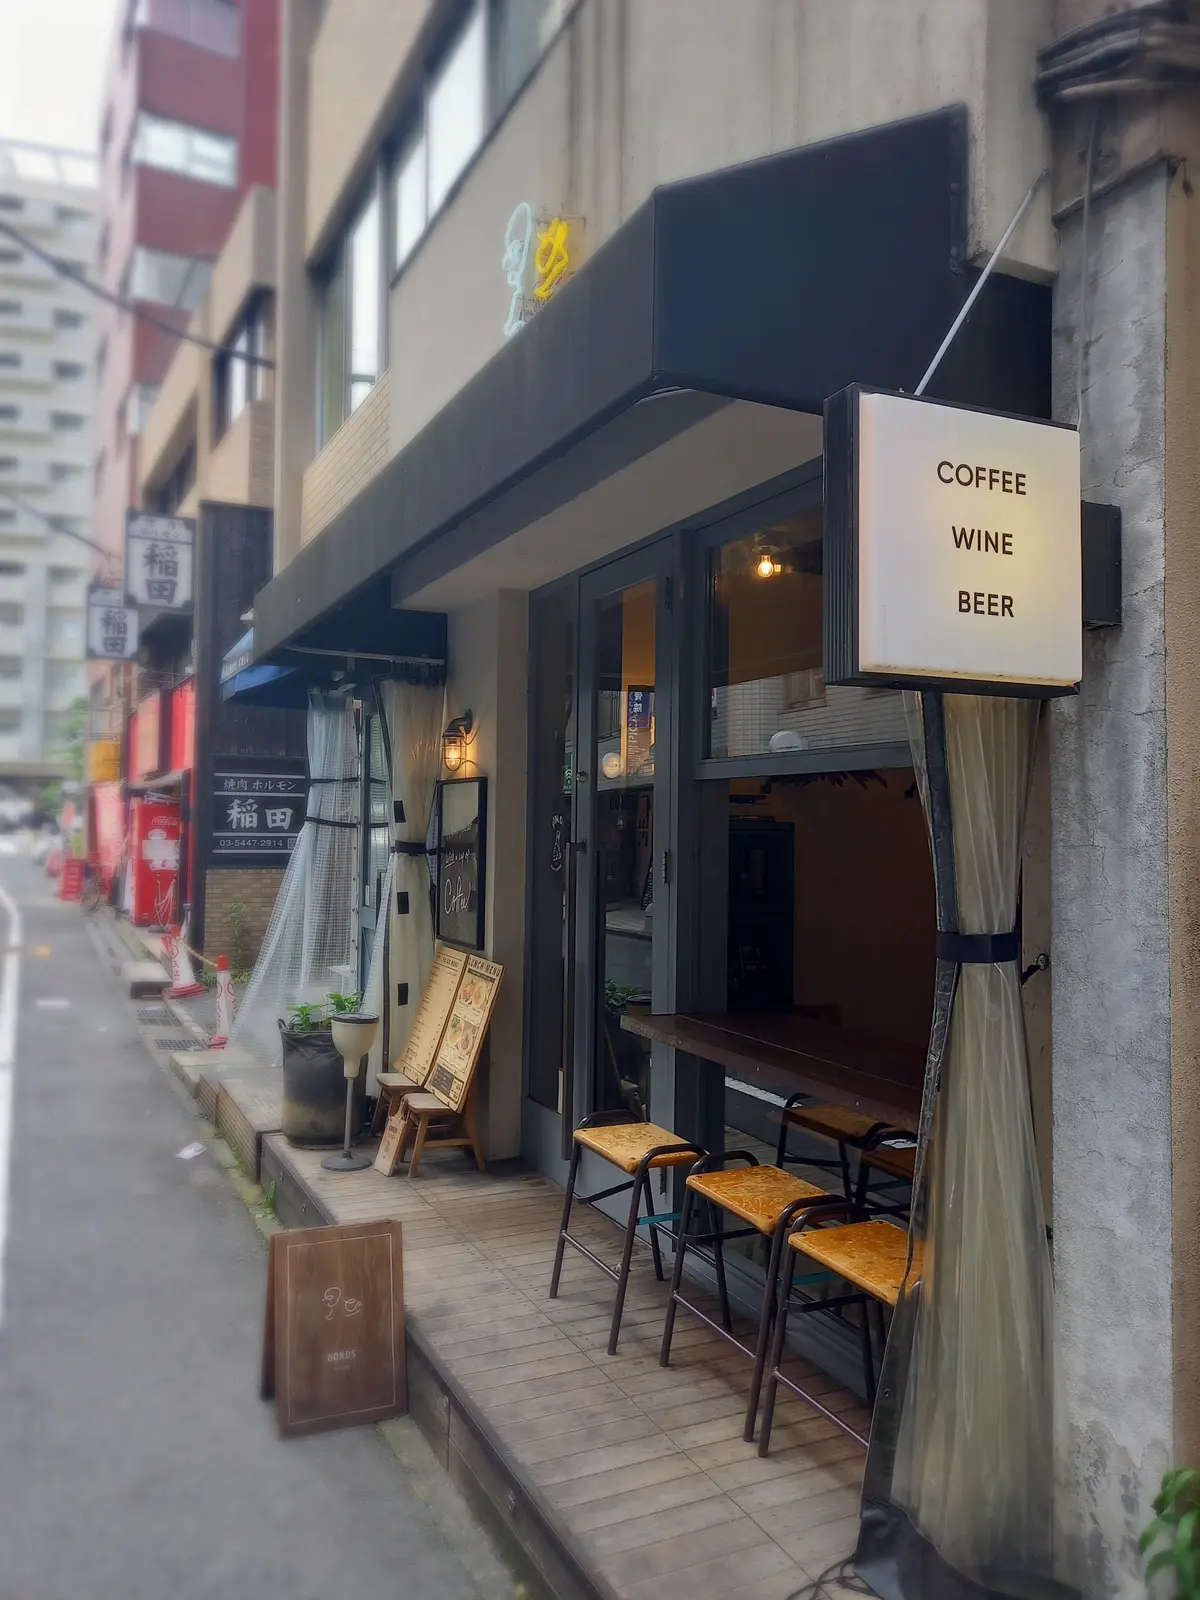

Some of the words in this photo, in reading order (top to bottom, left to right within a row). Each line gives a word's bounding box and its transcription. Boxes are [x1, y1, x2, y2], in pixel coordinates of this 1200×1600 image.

[937, 460, 1027, 496] COFFEE
[951, 525, 1013, 556] WINE
[142, 543, 180, 605] 稲田
[958, 590, 1015, 618] BEER
[100, 609, 128, 655] 稲田
[223, 779, 248, 791] 焼肉
[252, 780, 297, 791] ホルモン
[226, 798, 294, 830] 稲田
[220, 839, 283, 847] 03-5447-2914
[467, 956, 485, 970] LUNCH
[486, 963, 502, 978] MENU
[327, 1349, 357, 1362] BONDS
